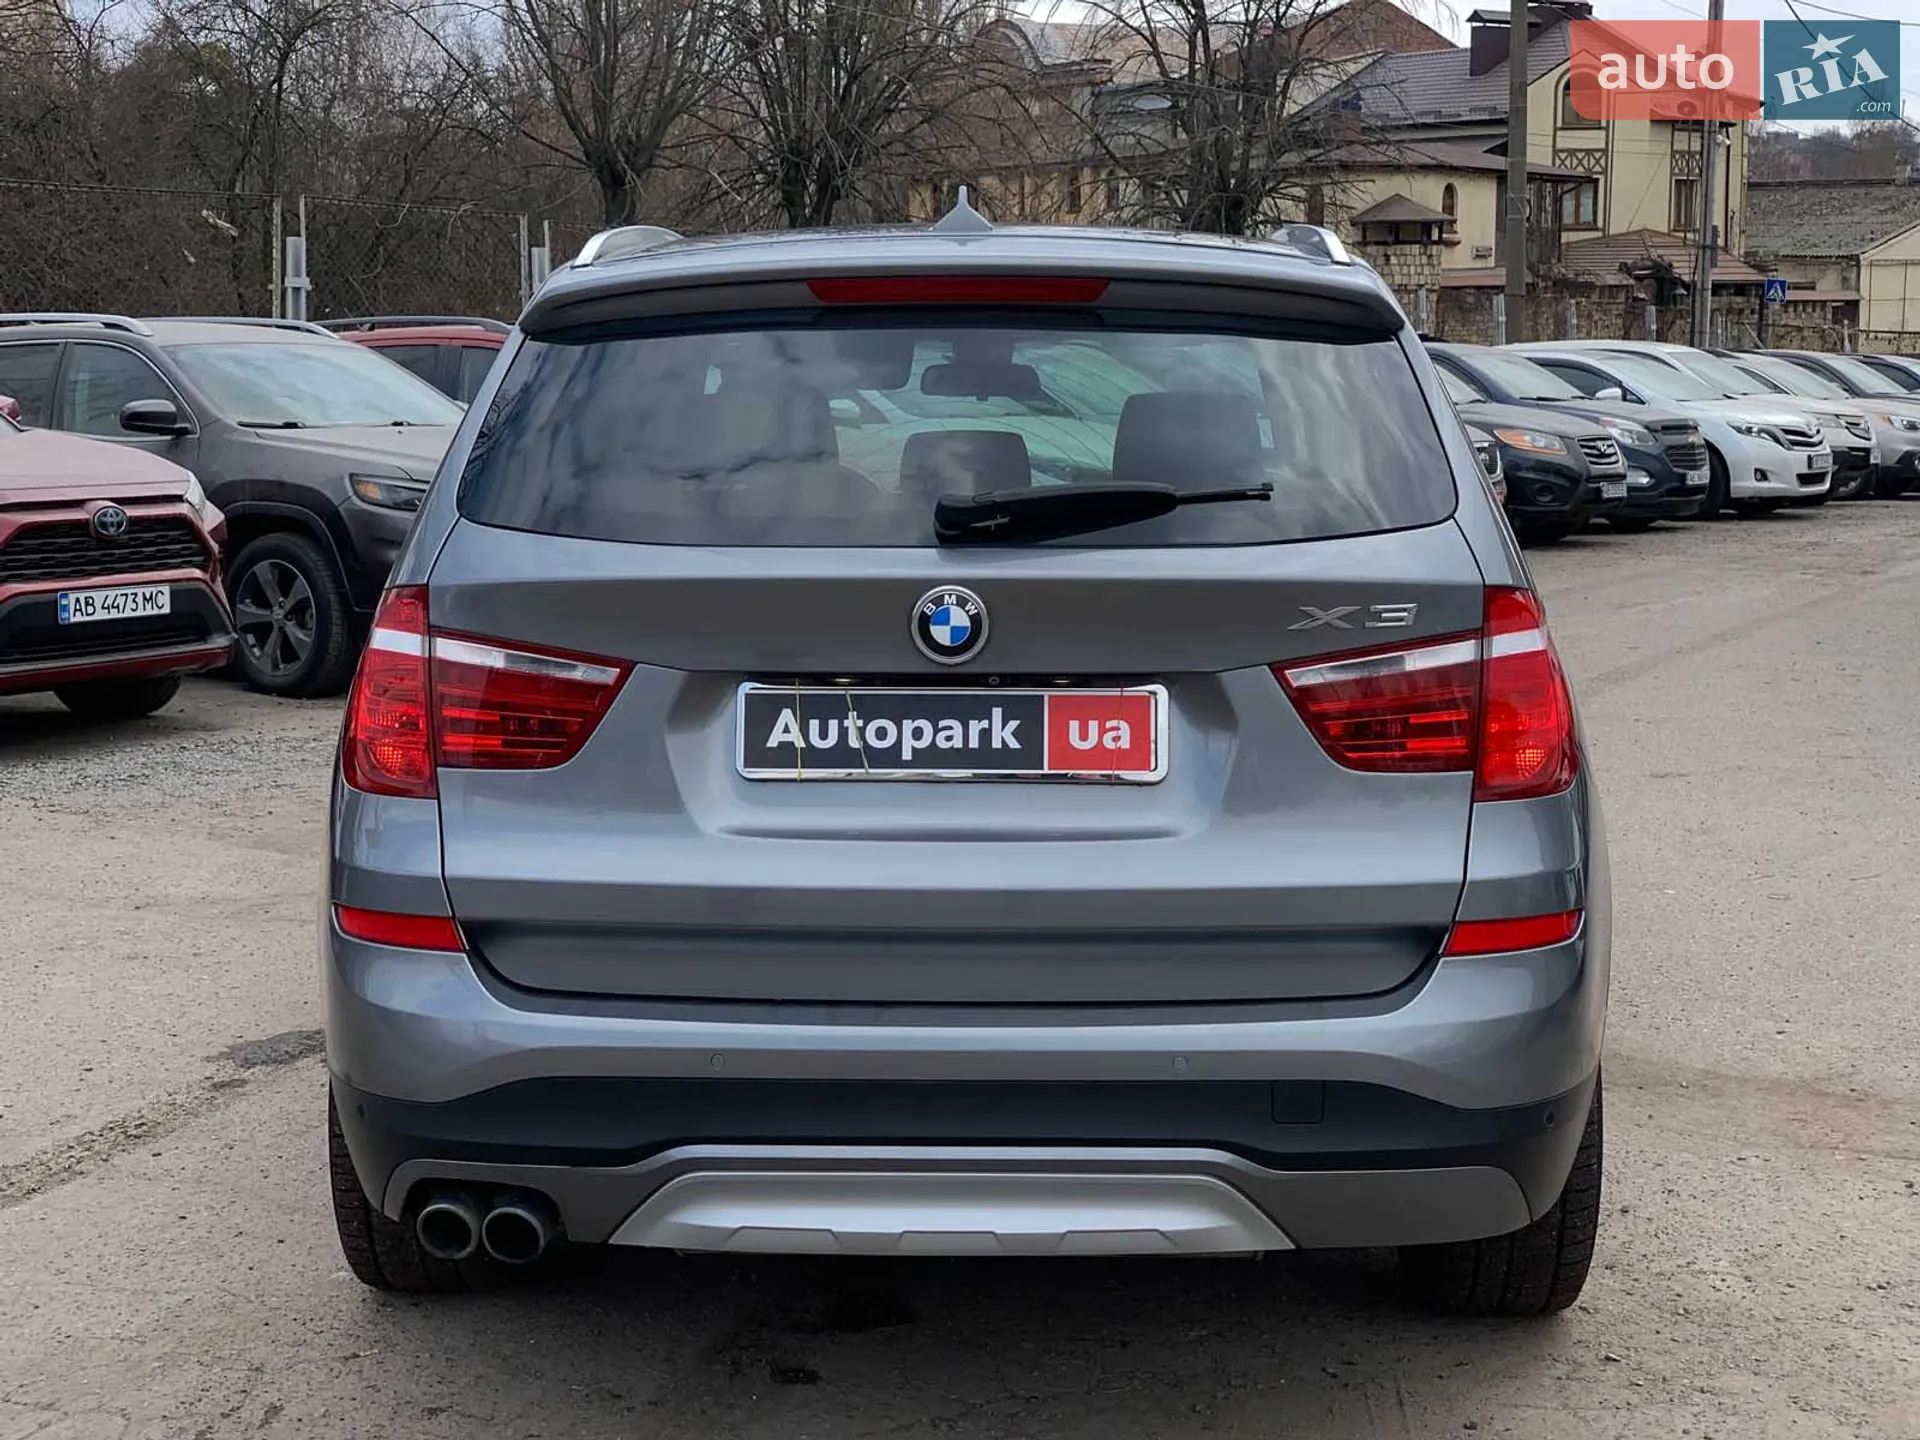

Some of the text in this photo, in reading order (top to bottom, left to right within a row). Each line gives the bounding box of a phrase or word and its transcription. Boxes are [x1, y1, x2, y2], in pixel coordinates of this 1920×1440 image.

[72, 590, 165, 618] AB 4473 MC
[923, 594, 979, 616] BMW
[1286, 603, 1418, 631] X3
[766, 707, 1131, 760] Autopark ua
